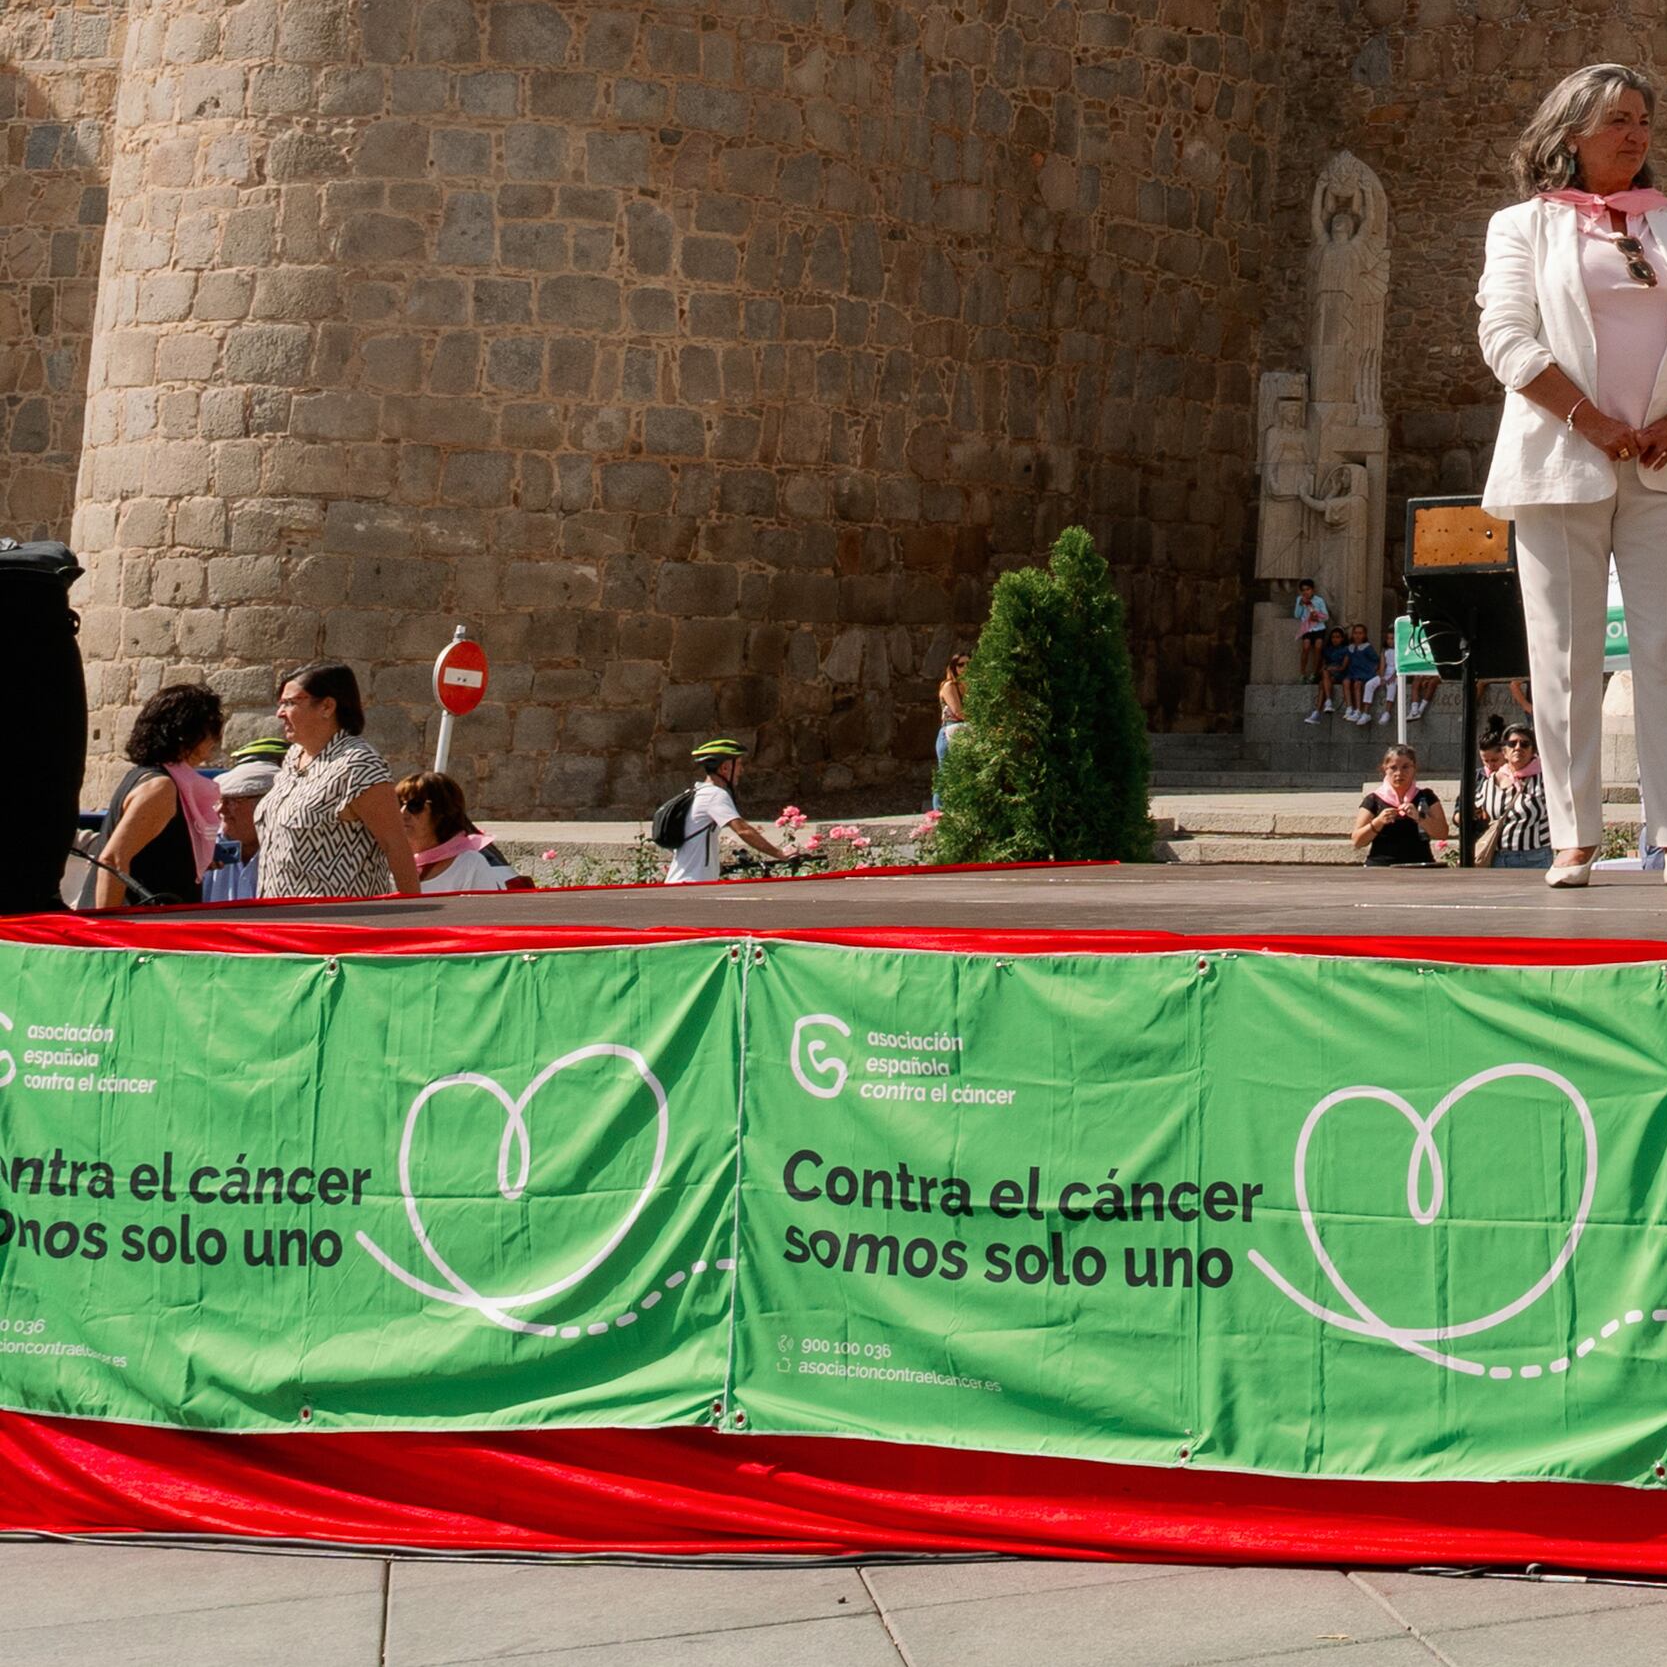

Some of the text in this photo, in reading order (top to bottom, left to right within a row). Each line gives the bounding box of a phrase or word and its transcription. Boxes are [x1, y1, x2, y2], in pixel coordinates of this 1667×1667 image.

[25, 1022, 116, 1044] asociación
[866, 1031, 964, 1052] asociación
[22, 1047, 100, 1070] española
[863, 1056, 950, 1079] española
[24, 1074, 156, 1094] contra el cáncer
[857, 1080, 1016, 1105] contra el cáncer
[130, 1152, 176, 1202] el
[189, 1153, 371, 1205] cáncer
[783, 1149, 1263, 1222] Contra el cáncer
[122, 1214, 227, 1265] solo
[244, 1229, 342, 1267] uno
[784, 1225, 1233, 1288] somos solo uno
[13, 1318, 46, 1336] 036
[801, 1338, 892, 1360] 900 100 036
